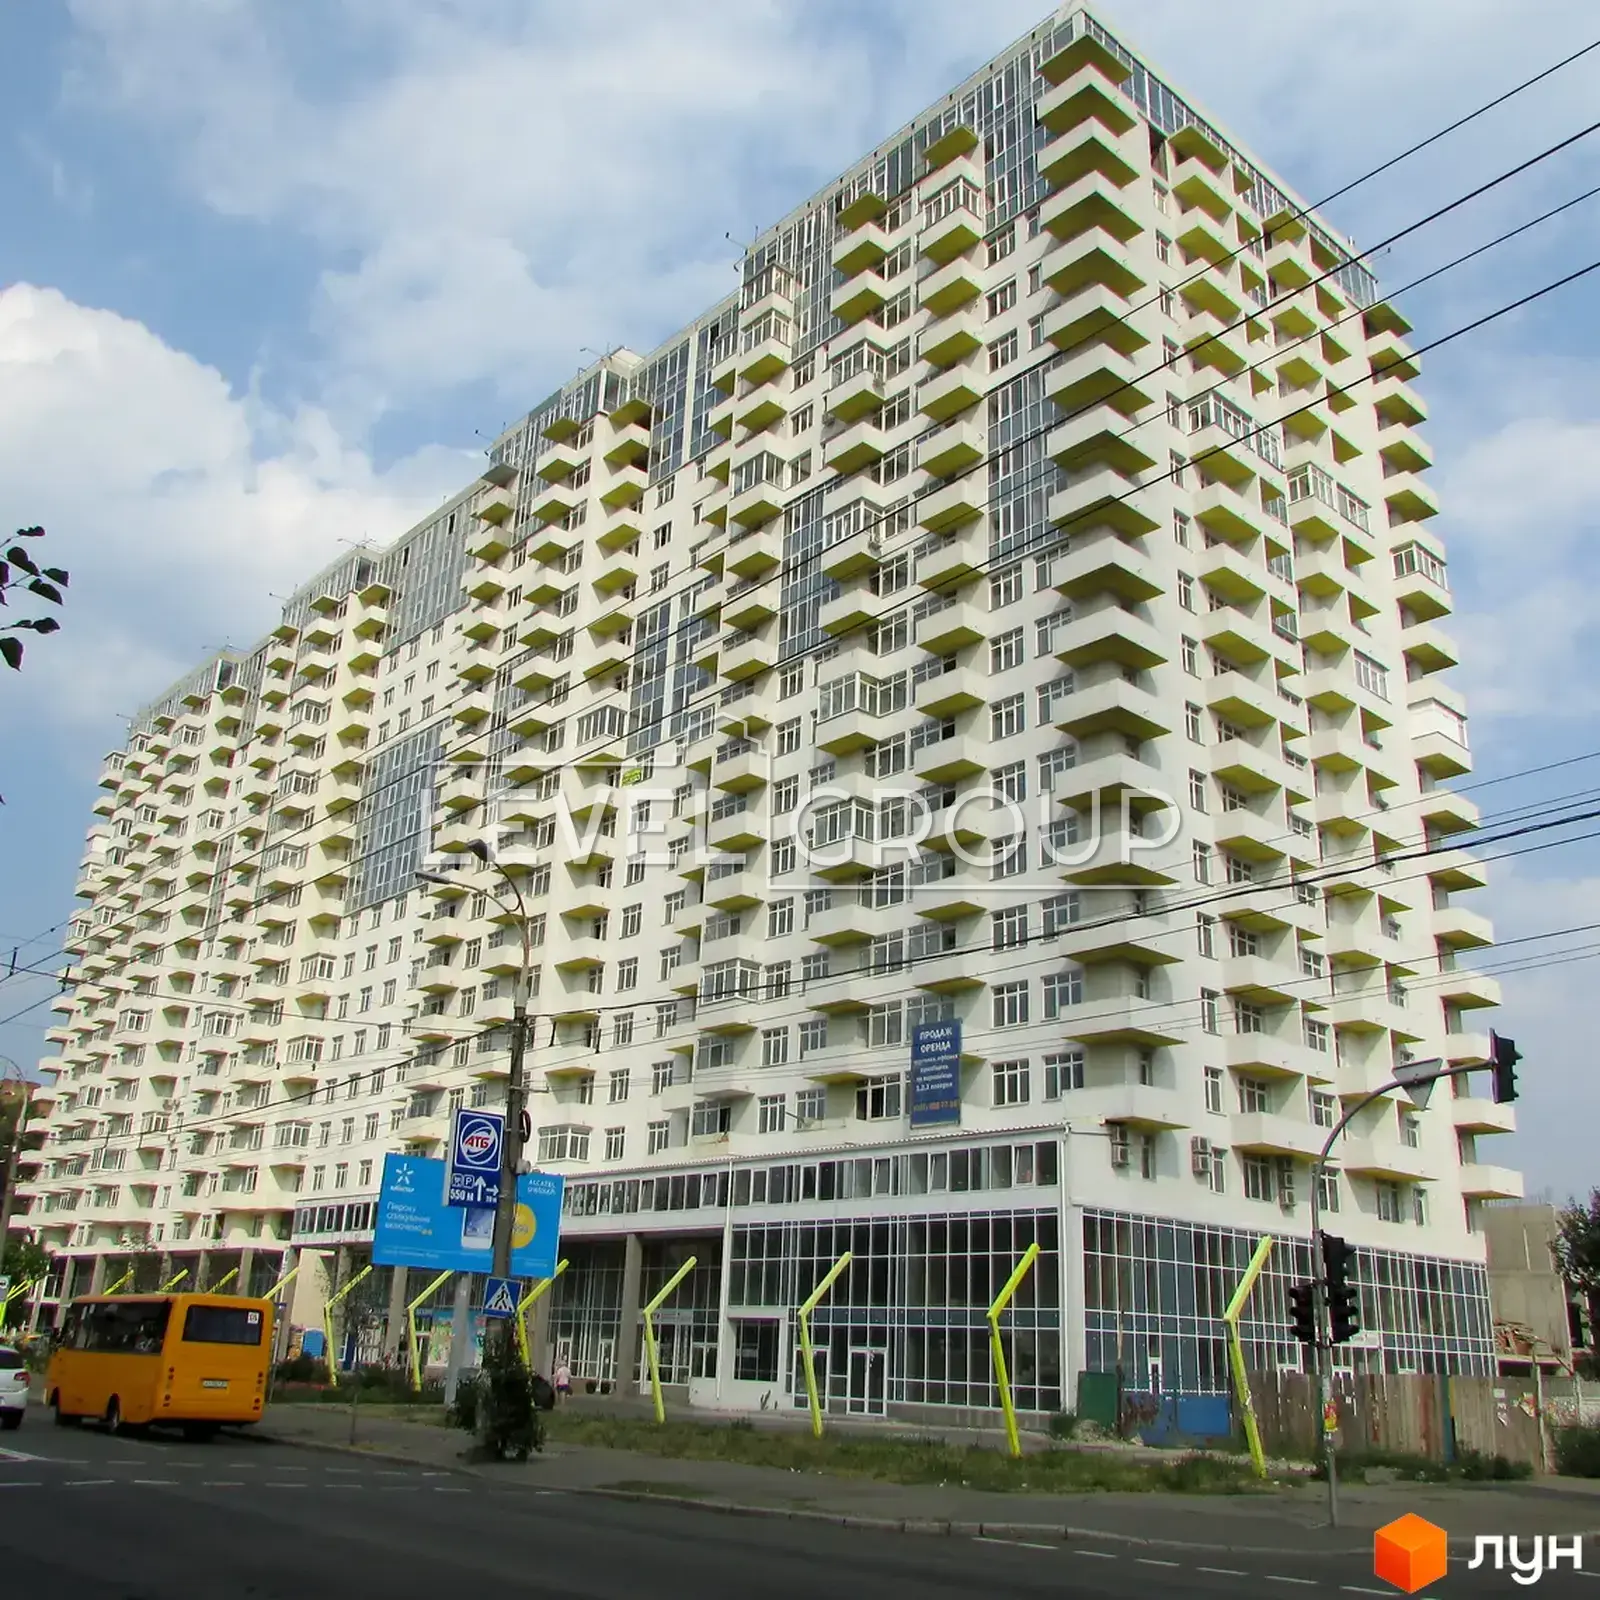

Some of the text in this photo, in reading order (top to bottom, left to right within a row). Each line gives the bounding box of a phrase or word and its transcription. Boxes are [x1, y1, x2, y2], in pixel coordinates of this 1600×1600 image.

[919, 1027, 952, 1041] ПРОДАЖ
[920, 1041, 951, 1053] ОРЕНДА
[465, 1136, 490, 1149] АТБ
[450, 1188, 466, 1201] 550
